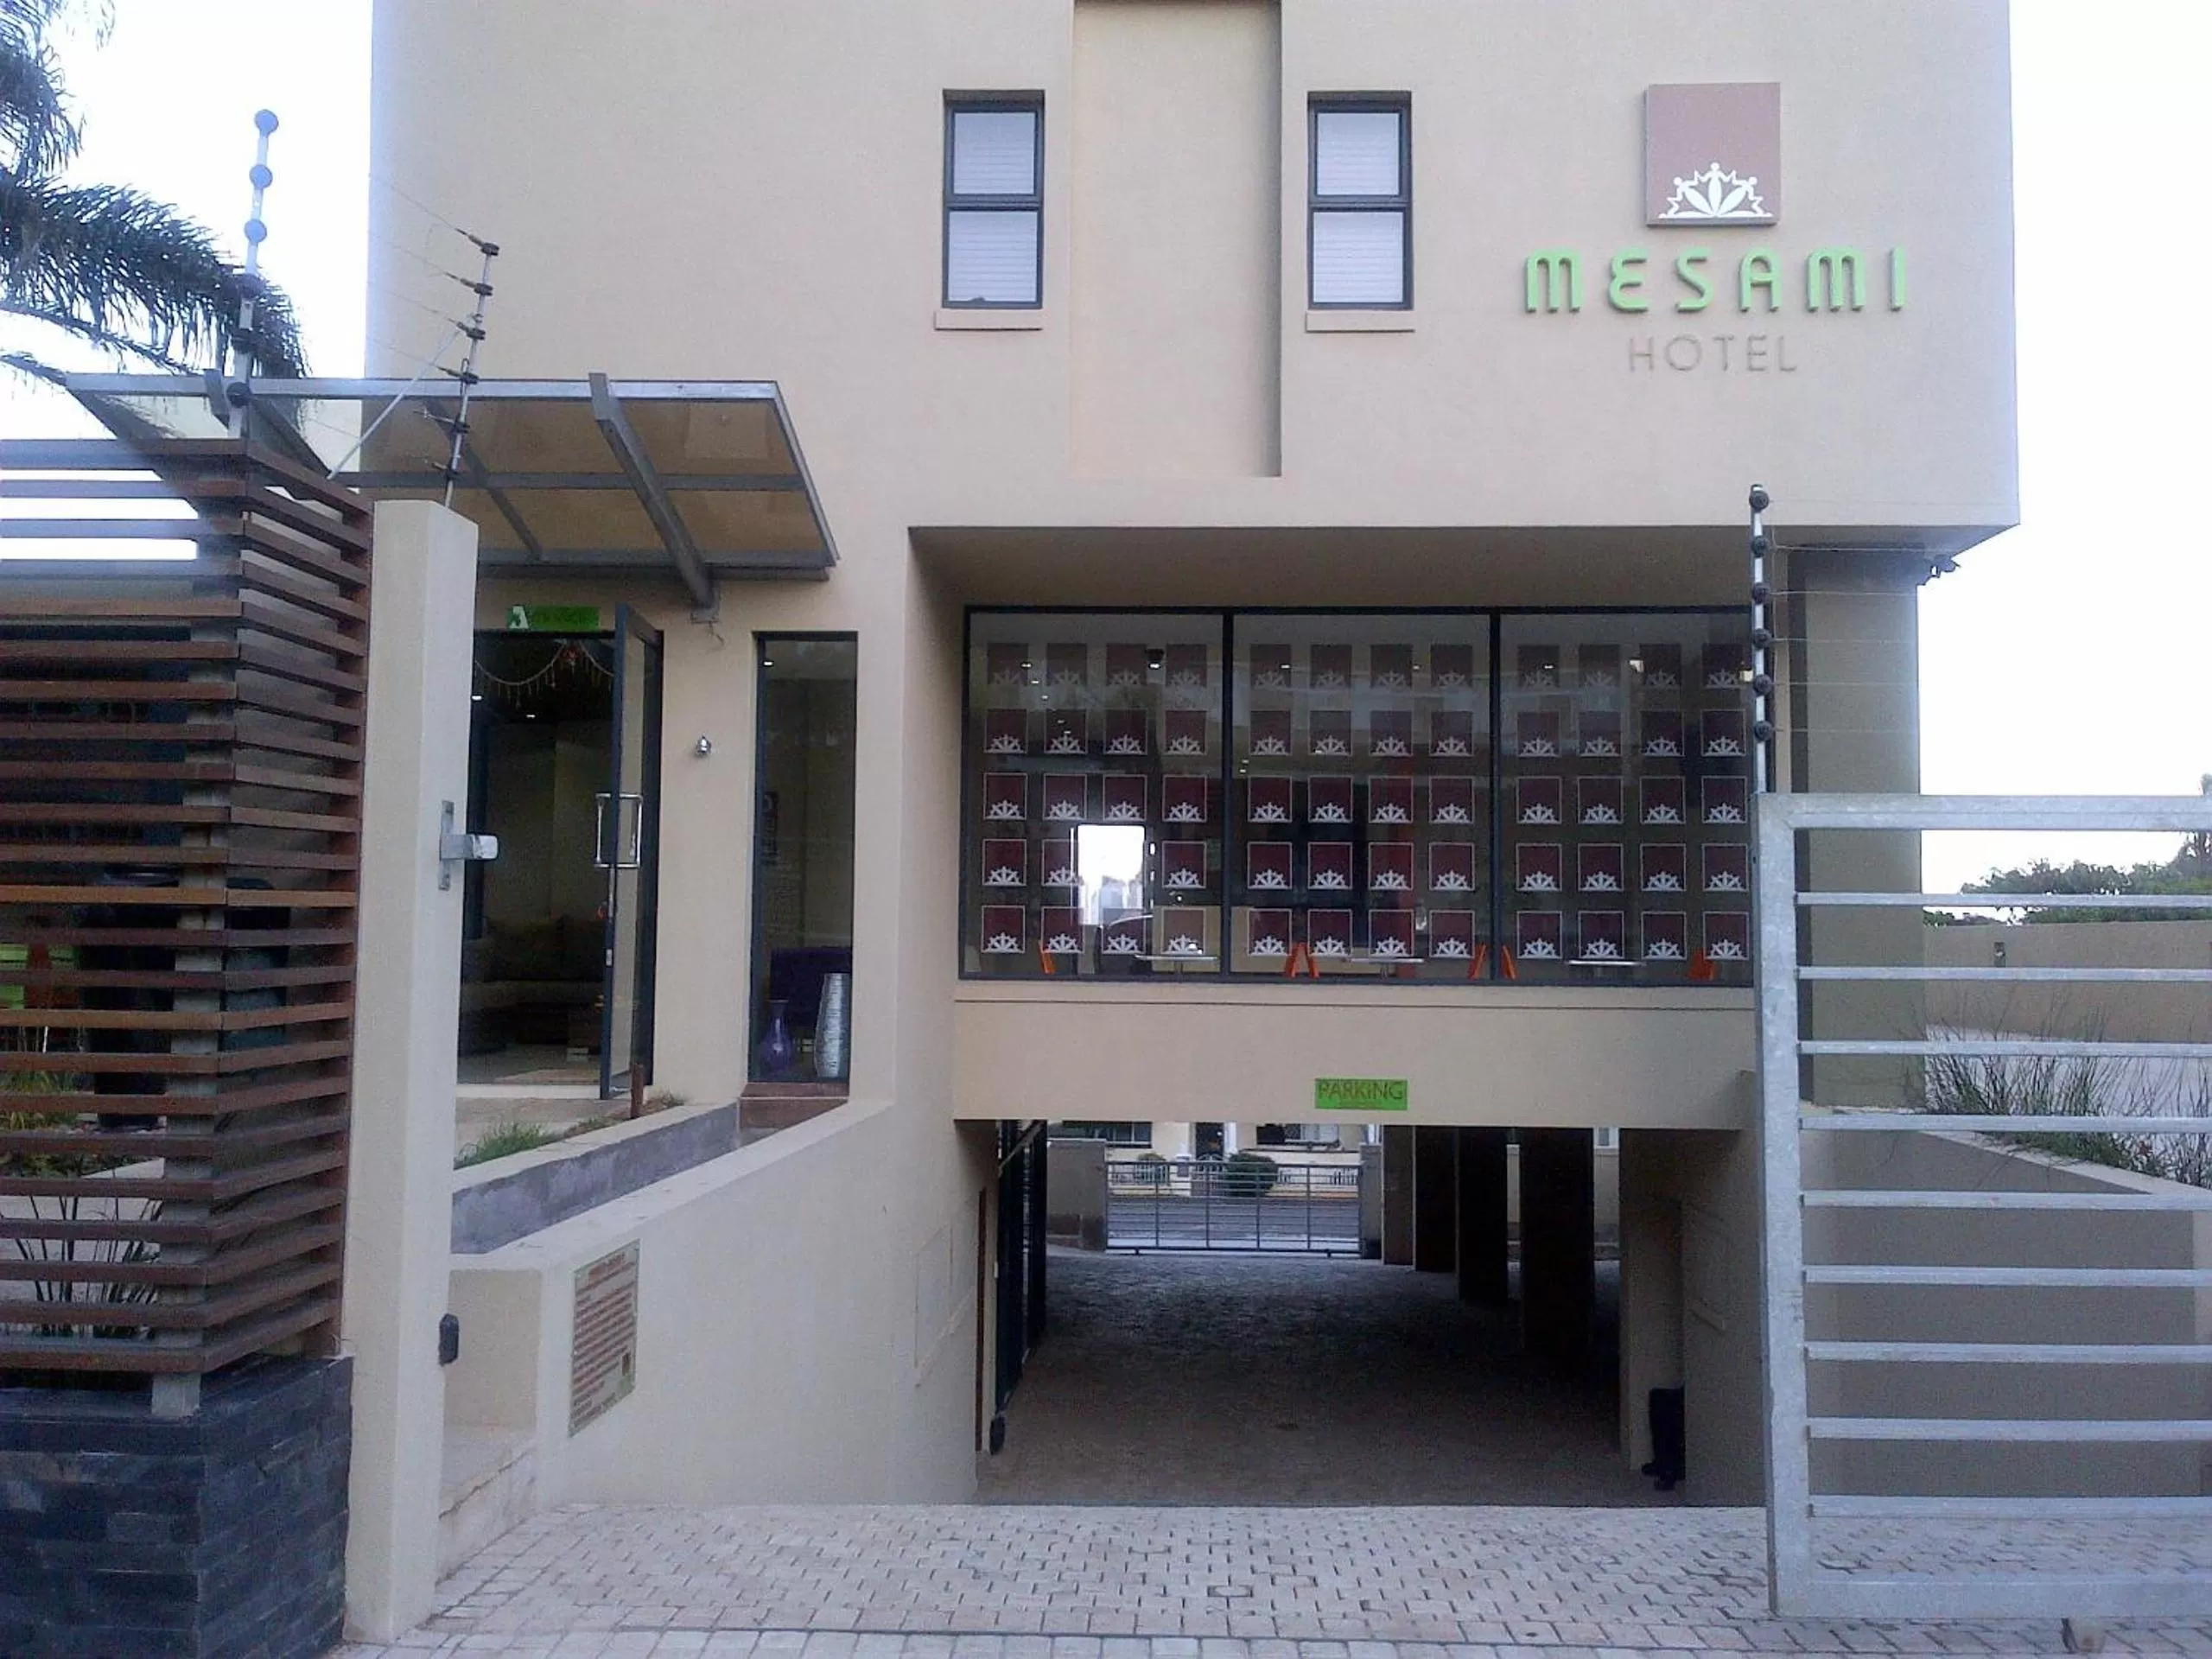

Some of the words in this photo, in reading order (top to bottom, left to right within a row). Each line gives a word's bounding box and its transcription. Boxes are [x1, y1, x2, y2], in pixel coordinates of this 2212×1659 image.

[1523, 246, 1907, 313] MESAMI
[1628, 334, 1798, 372] HOTEL
[1319, 1081, 1404, 1100] PARKING
